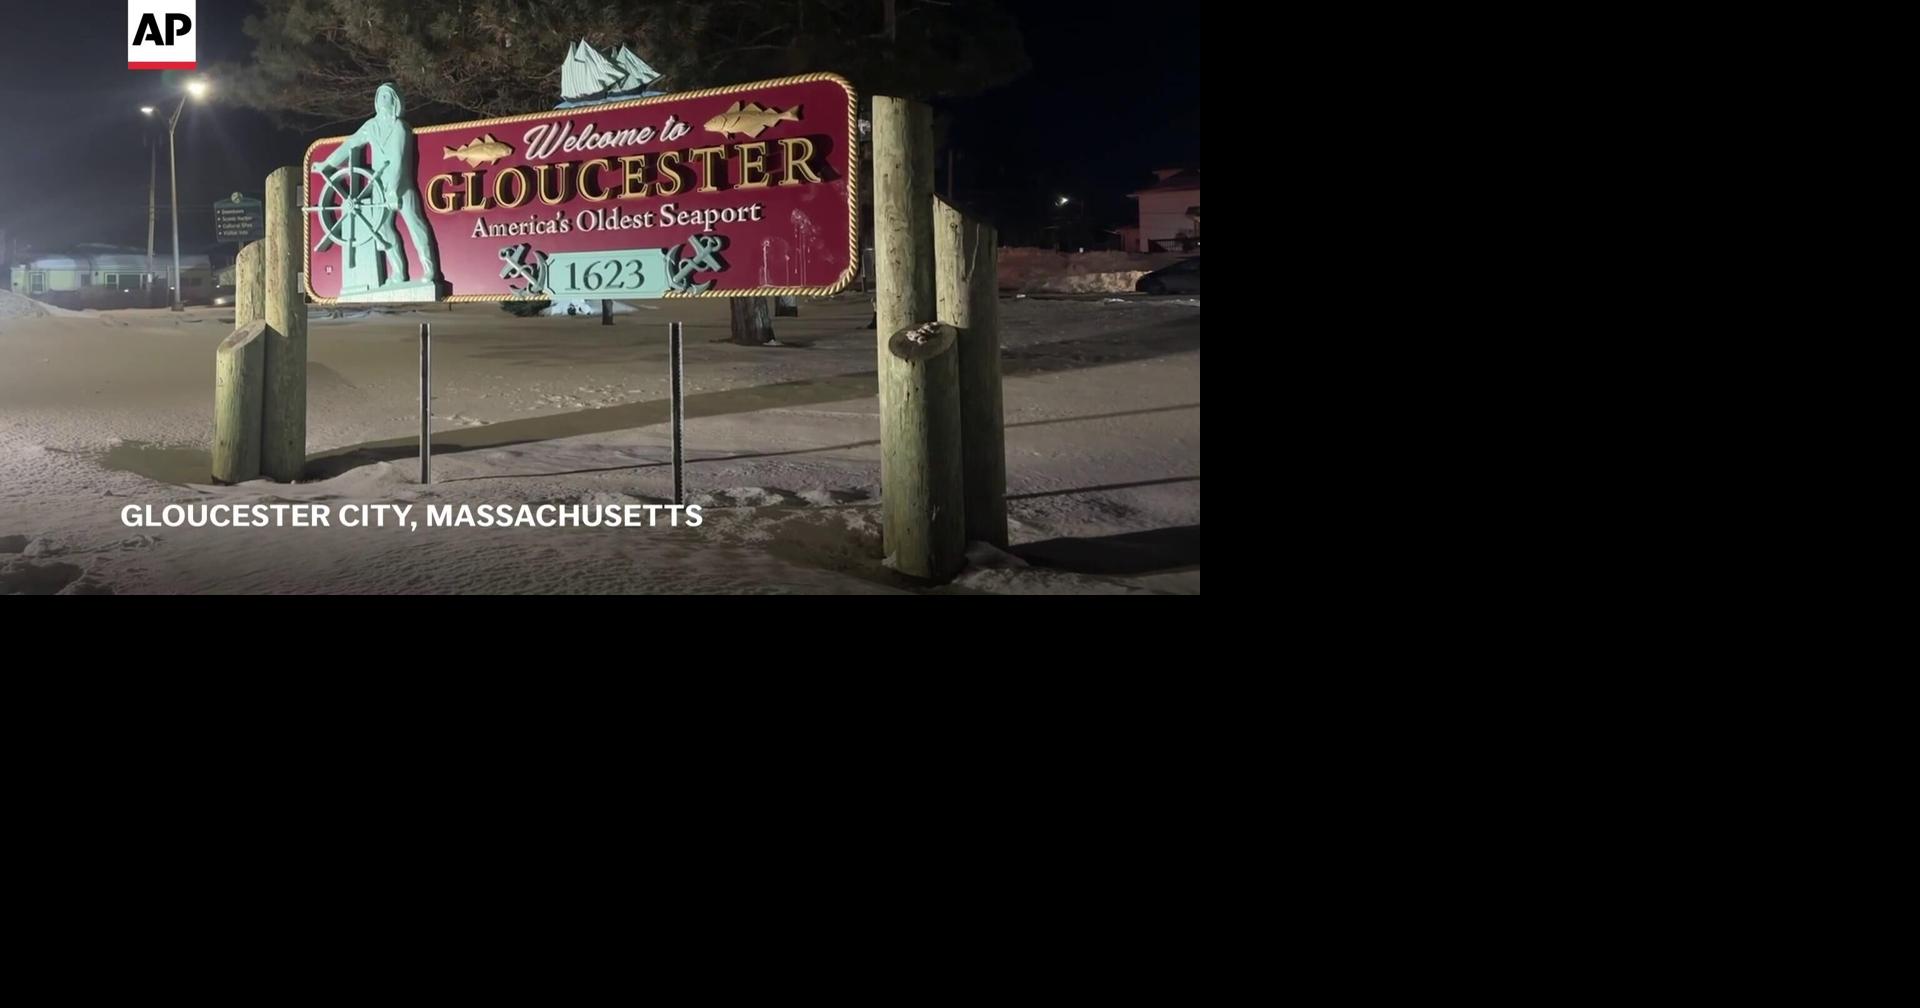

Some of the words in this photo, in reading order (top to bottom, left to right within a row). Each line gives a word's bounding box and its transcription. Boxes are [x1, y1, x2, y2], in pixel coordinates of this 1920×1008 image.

[523, 119, 655, 161] Welcome
[660, 114, 692, 142] to
[427, 137, 823, 215] GLOUCESTER
[471, 211, 570, 239] America's
[576, 208, 654, 232] Oldest
[660, 202, 762, 233] Seaport
[564, 258, 646, 292] 1623
